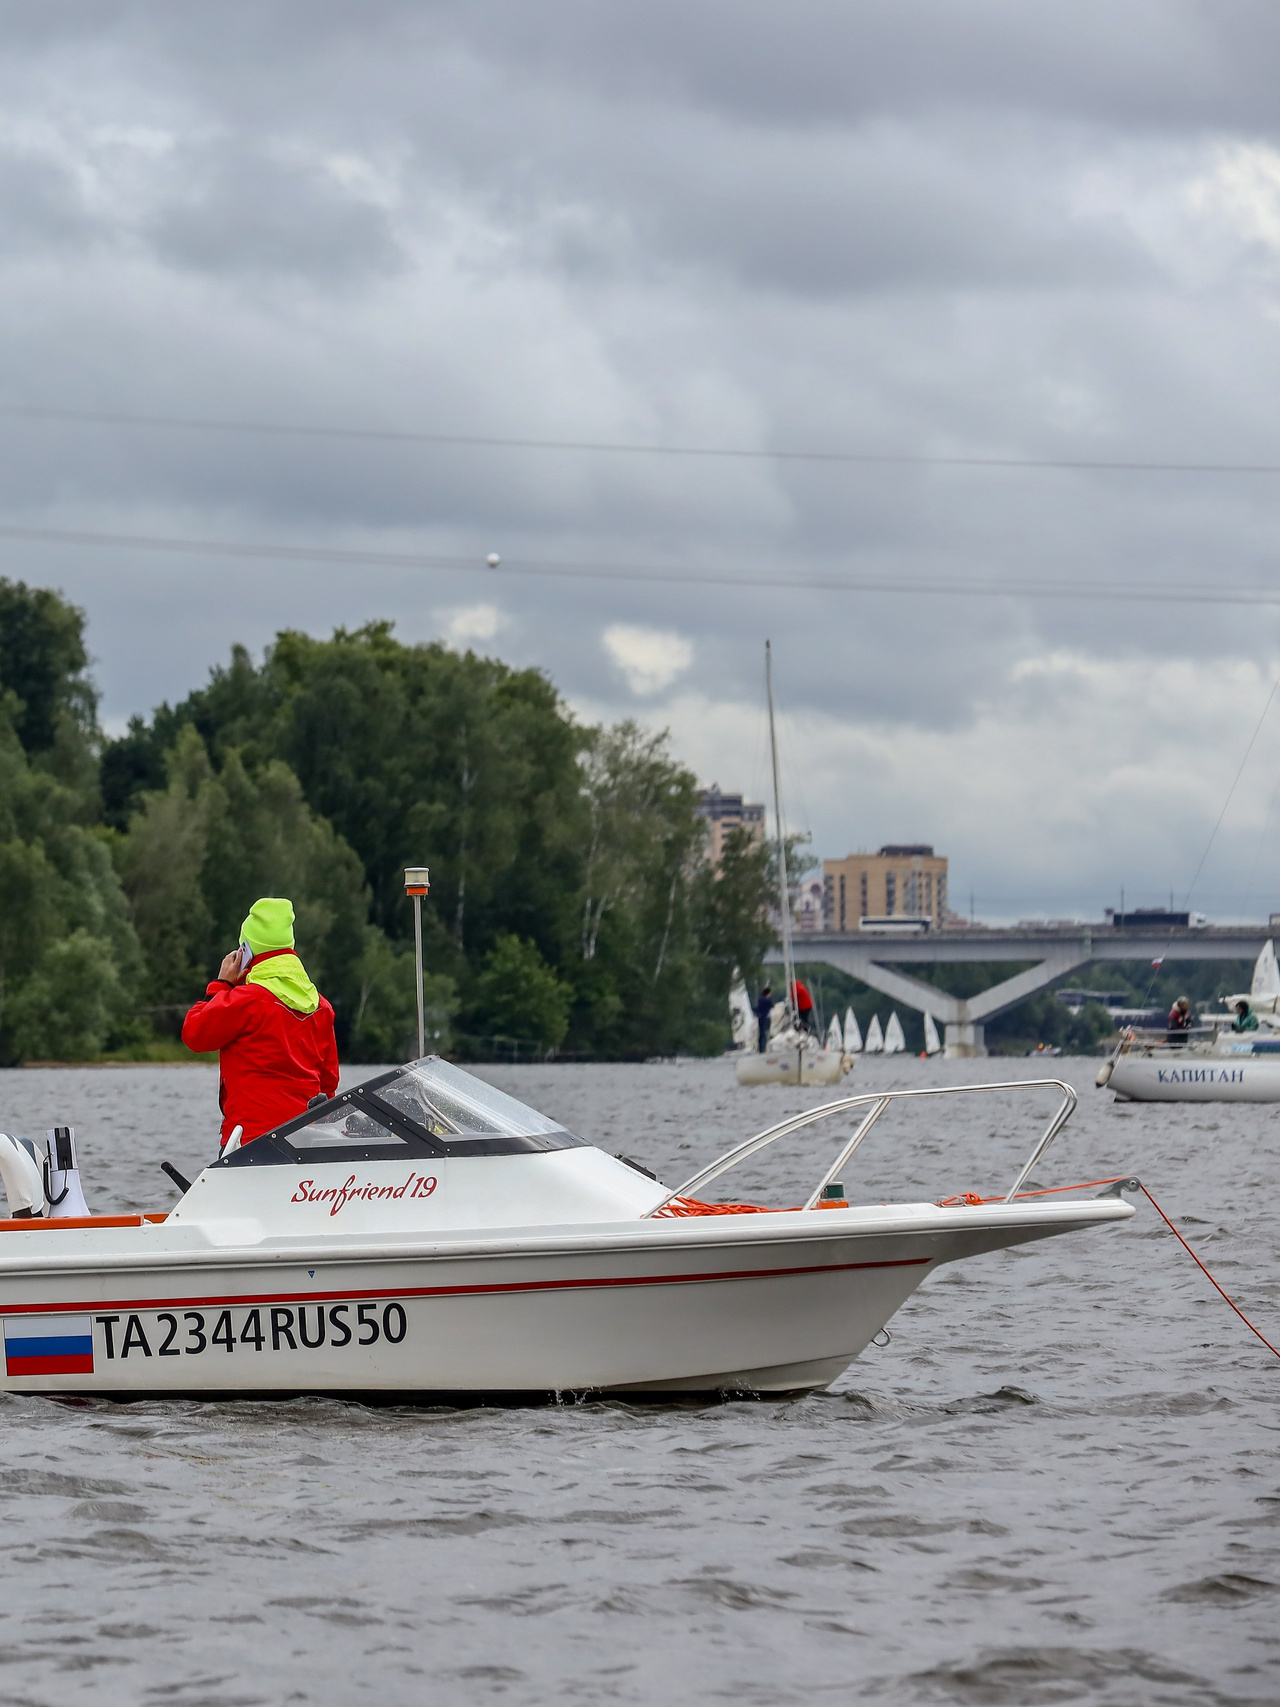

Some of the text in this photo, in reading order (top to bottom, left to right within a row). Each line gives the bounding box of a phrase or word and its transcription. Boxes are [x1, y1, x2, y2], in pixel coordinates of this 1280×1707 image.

[1158, 1069, 1244, 1083] КАПИТАН
[290, 1172, 438, 1216] Sunfriend 19
